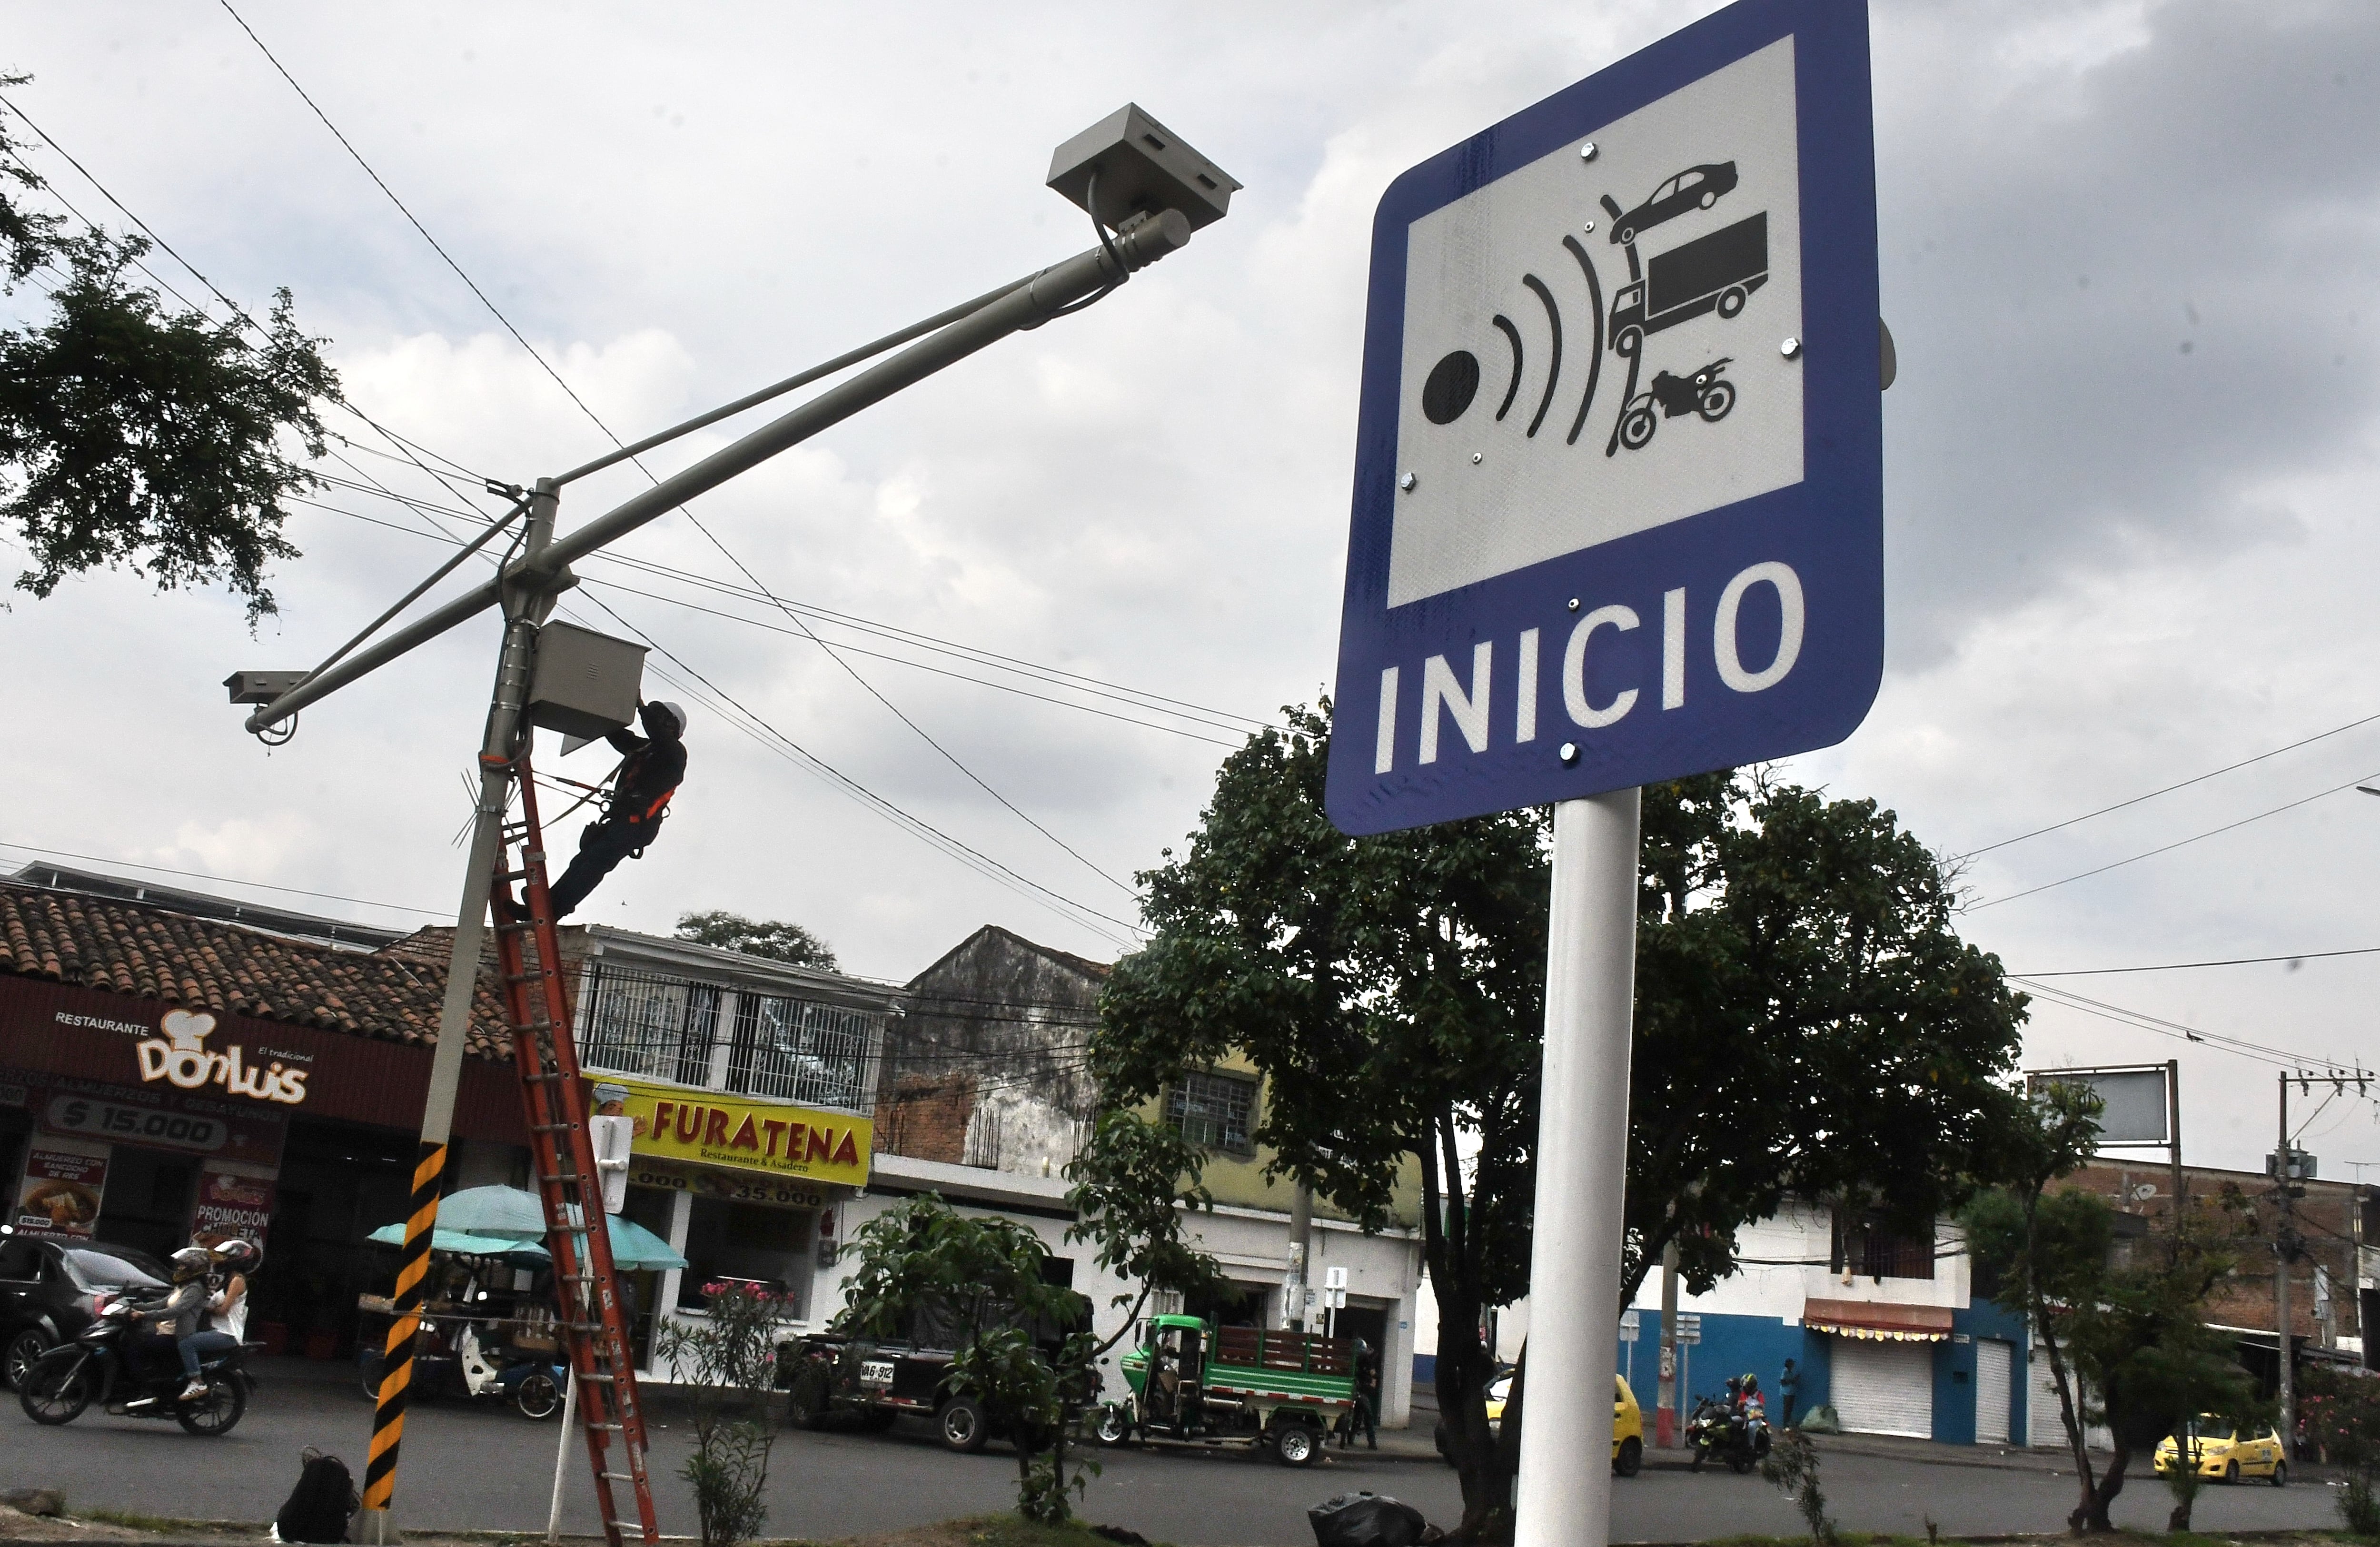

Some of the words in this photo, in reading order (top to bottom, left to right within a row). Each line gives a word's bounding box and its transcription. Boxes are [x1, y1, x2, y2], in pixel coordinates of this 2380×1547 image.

[1375, 561, 1805, 775] INICIO
[56, 1012, 149, 1037] RESTAURANTE
[258, 1047, 268, 1055] El
[269, 1049, 314, 1063] tradicional
[56, 1077, 161, 1104] ALMUERZOS
[63, 1101, 90, 1127] $
[101, 1106, 214, 1143] 15.000
[651, 1101, 860, 1167] FURATENA
[700, 1148, 759, 1166] Restaurante
[761, 1157, 768, 1166] &
[770, 1159, 809, 1172] Asadero
[198, 1205, 269, 1228] PROMOCIÓN
[878, 1366, 893, 1378] 912
